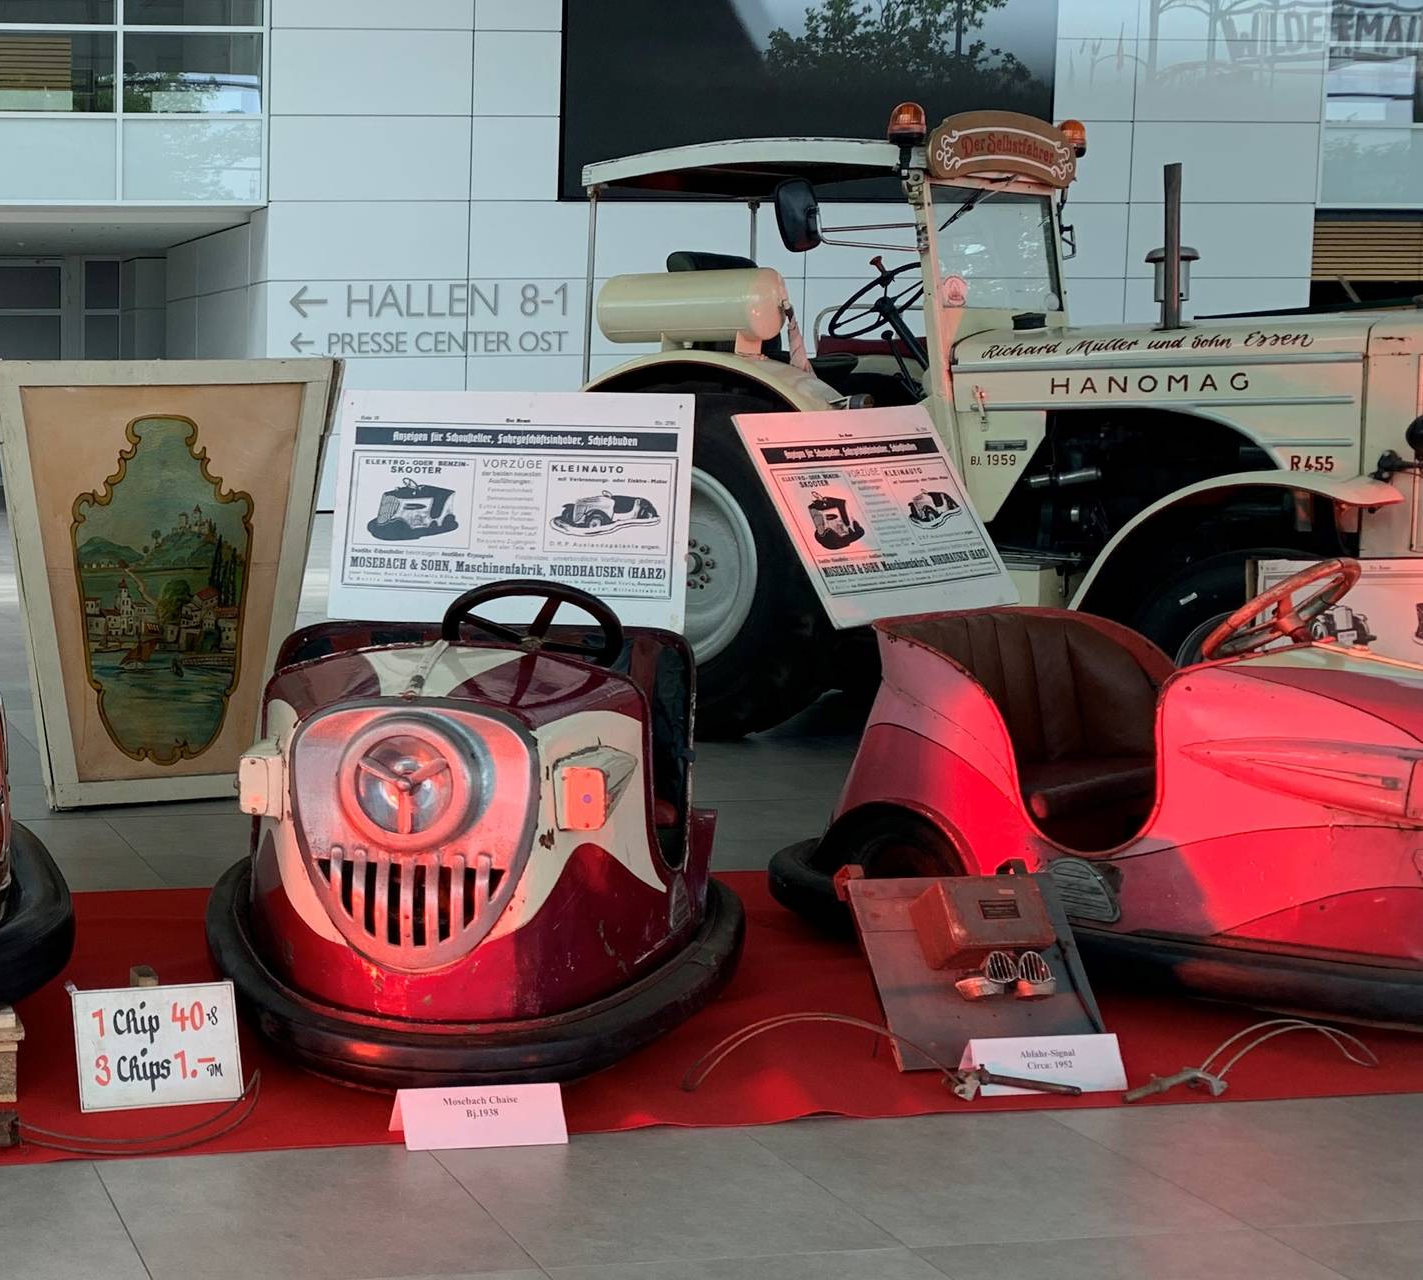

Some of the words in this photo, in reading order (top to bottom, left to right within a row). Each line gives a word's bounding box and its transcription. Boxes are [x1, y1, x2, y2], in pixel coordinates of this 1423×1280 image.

[961, 135, 986, 157] Der
[987, 132, 1055, 164] Selbstfahrer
[346, 283, 500, 318] HALLEN
[519, 282, 570, 317] 8-1
[327, 332, 408, 354] PRESSE
[414, 331, 512, 353] CENTER
[518, 330, 570, 353] OST
[982, 341, 1062, 359] Richard
[1066, 338, 1139, 356] Müller
[1147, 335, 1187, 350] und
[1191, 333, 1232, 350] Sohn
[1243, 330, 1315, 348] Essen
[1050, 372, 1250, 395] HANOMAG
[430, 431, 443, 443] für
[482, 457, 543, 469] VORZÜGE
[987, 454, 1017, 466] 1959
[1290, 455, 1302, 471] R
[1304, 455, 1335, 472] 455
[390, 465, 442, 474] SKOOTER
[551, 464, 625, 474] KLEINAUTO
[884, 467, 923, 476] KLEINAUTO
[798, 480, 830, 488] SKOOTER
[350, 556, 407, 570] MOSEBACH
[409, 558, 418, 570] &
[420, 559, 453, 573] SOHN,
[455, 561, 546, 577] Maschinenfabrik,
[549, 564, 625, 578] NORDHAUSEN
[627, 567, 666, 580] (HARZ)
[91, 1008, 105, 1038] 1
[113, 1001, 160, 1044] Chip
[171, 1000, 205, 1033] 40
[1020, 1048, 1076, 1059] Abfahr-Signal
[95, 1054, 111, 1087] 3
[117, 1047, 172, 1093] Chips
[206, 1062, 224, 1078] DM
[1055, 1060, 1073, 1069] 1952
[442, 1096, 487, 1106] Mosebach
[489, 1095, 519, 1105] Chaise
[466, 1107, 499, 1119] Bj.1938
